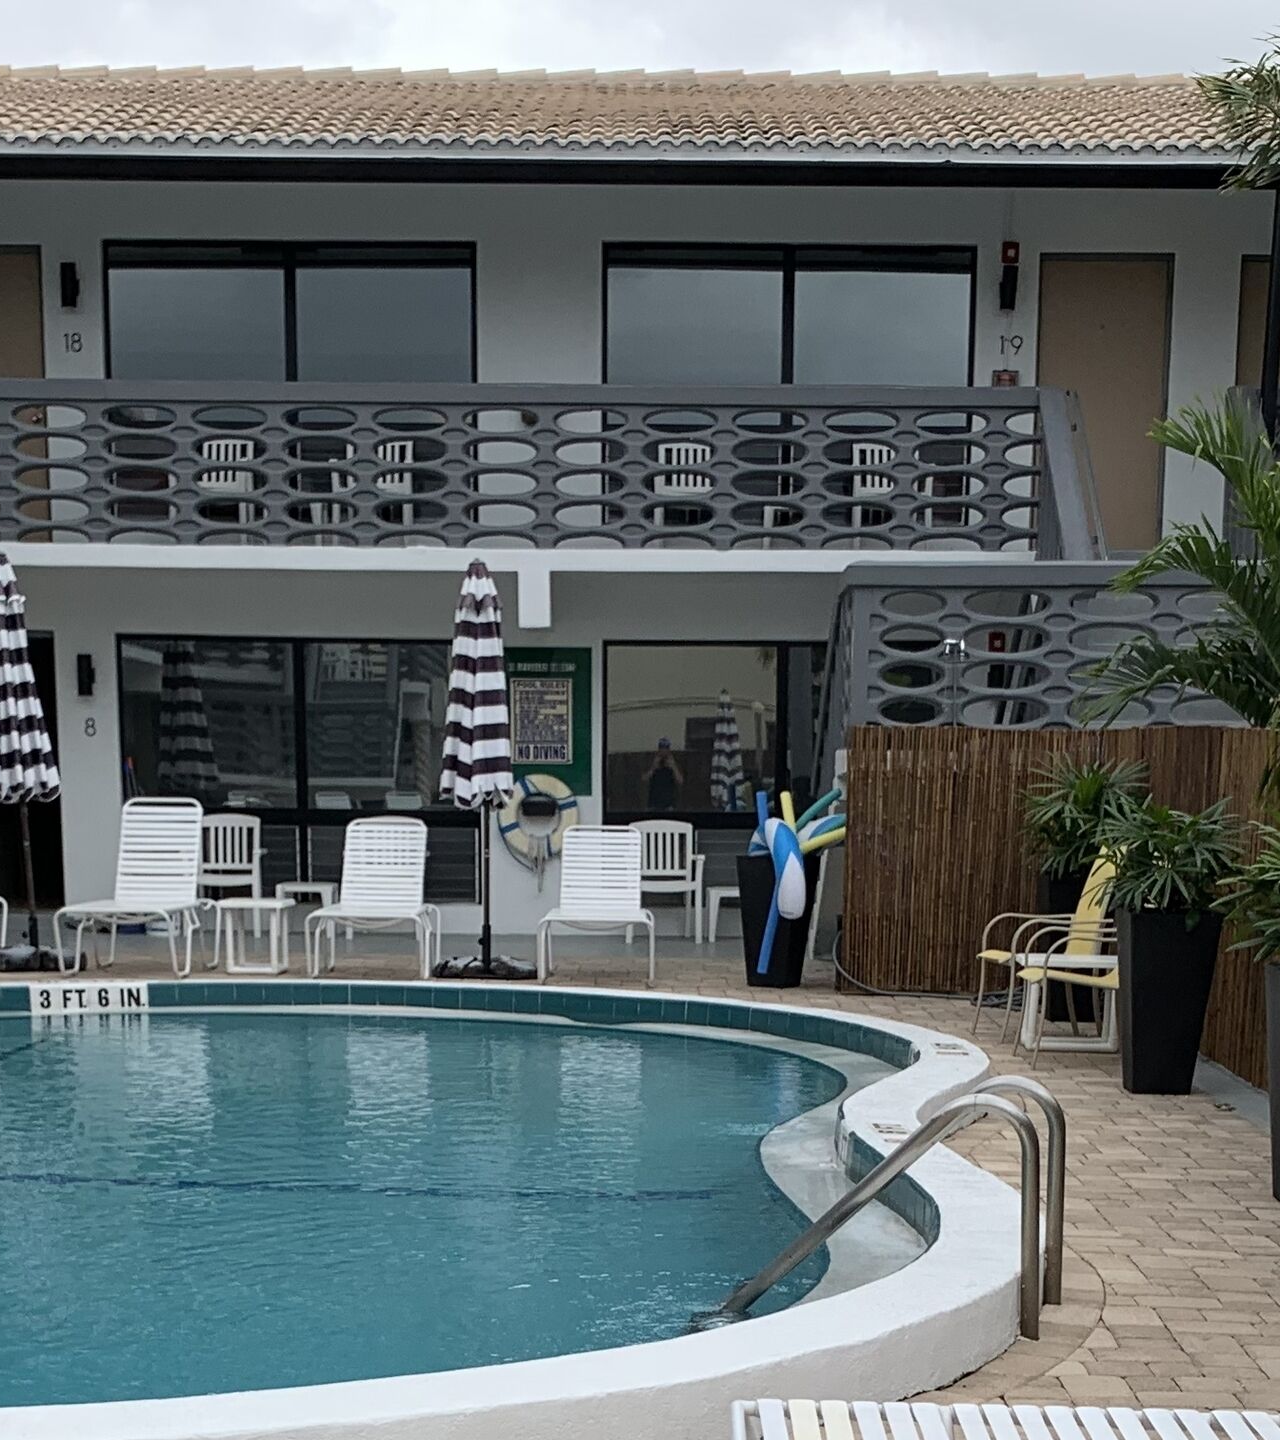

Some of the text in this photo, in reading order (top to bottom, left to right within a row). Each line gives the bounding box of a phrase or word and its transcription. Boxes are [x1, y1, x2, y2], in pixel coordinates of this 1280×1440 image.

[63, 332, 83, 353] 18
[999, 335, 1024, 356] 19
[84, 717, 97, 737] 8
[517, 744, 566, 760] NO DIVING
[39, 987, 145, 1009] 3 FT. 6 IN.
